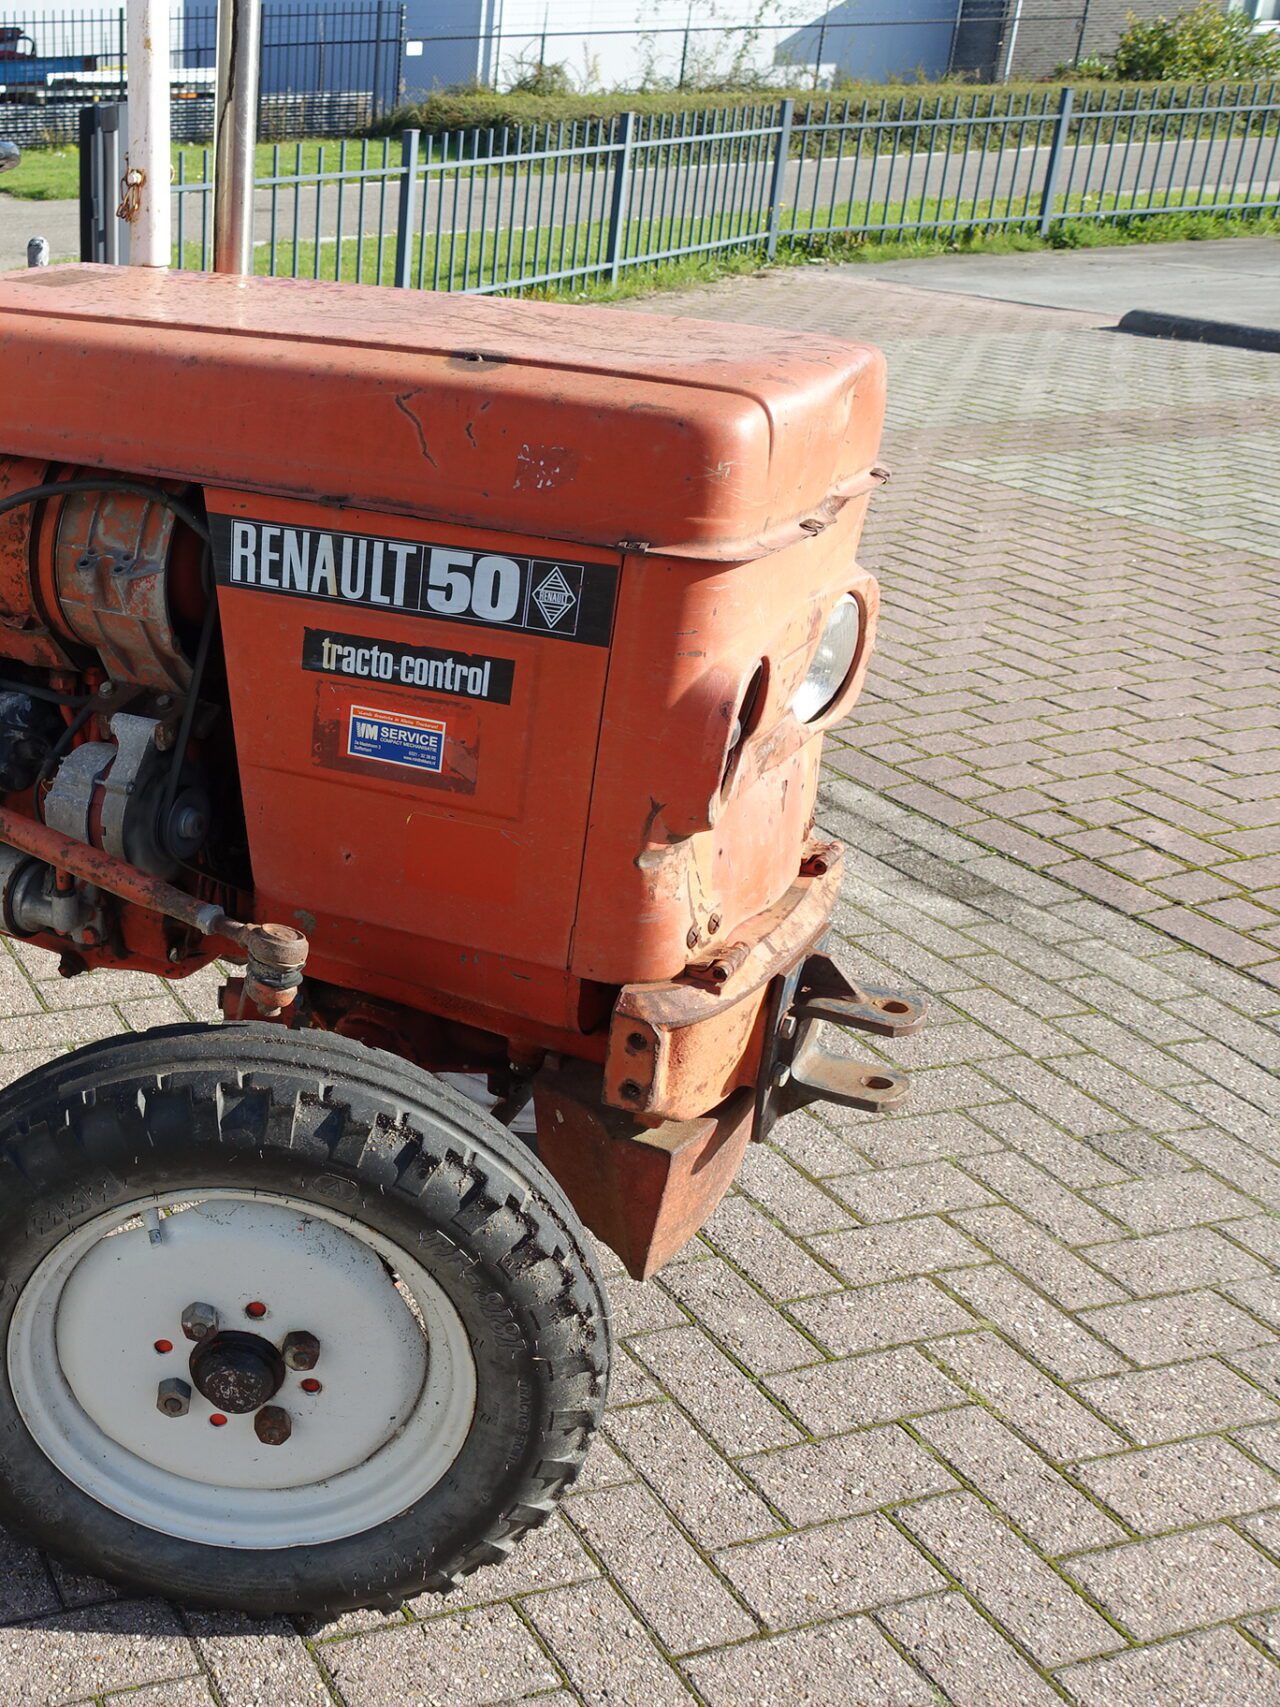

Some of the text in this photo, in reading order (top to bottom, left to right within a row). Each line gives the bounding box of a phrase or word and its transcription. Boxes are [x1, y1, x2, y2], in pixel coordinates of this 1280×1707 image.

[231, 521, 521, 622] RENAULT 50
[540, 590, 568, 605] RENAULT
[322, 637, 491, 697] tracto-control
[380, 727, 439, 748] SERVICE
[380, 737, 403, 746] COMPACT
